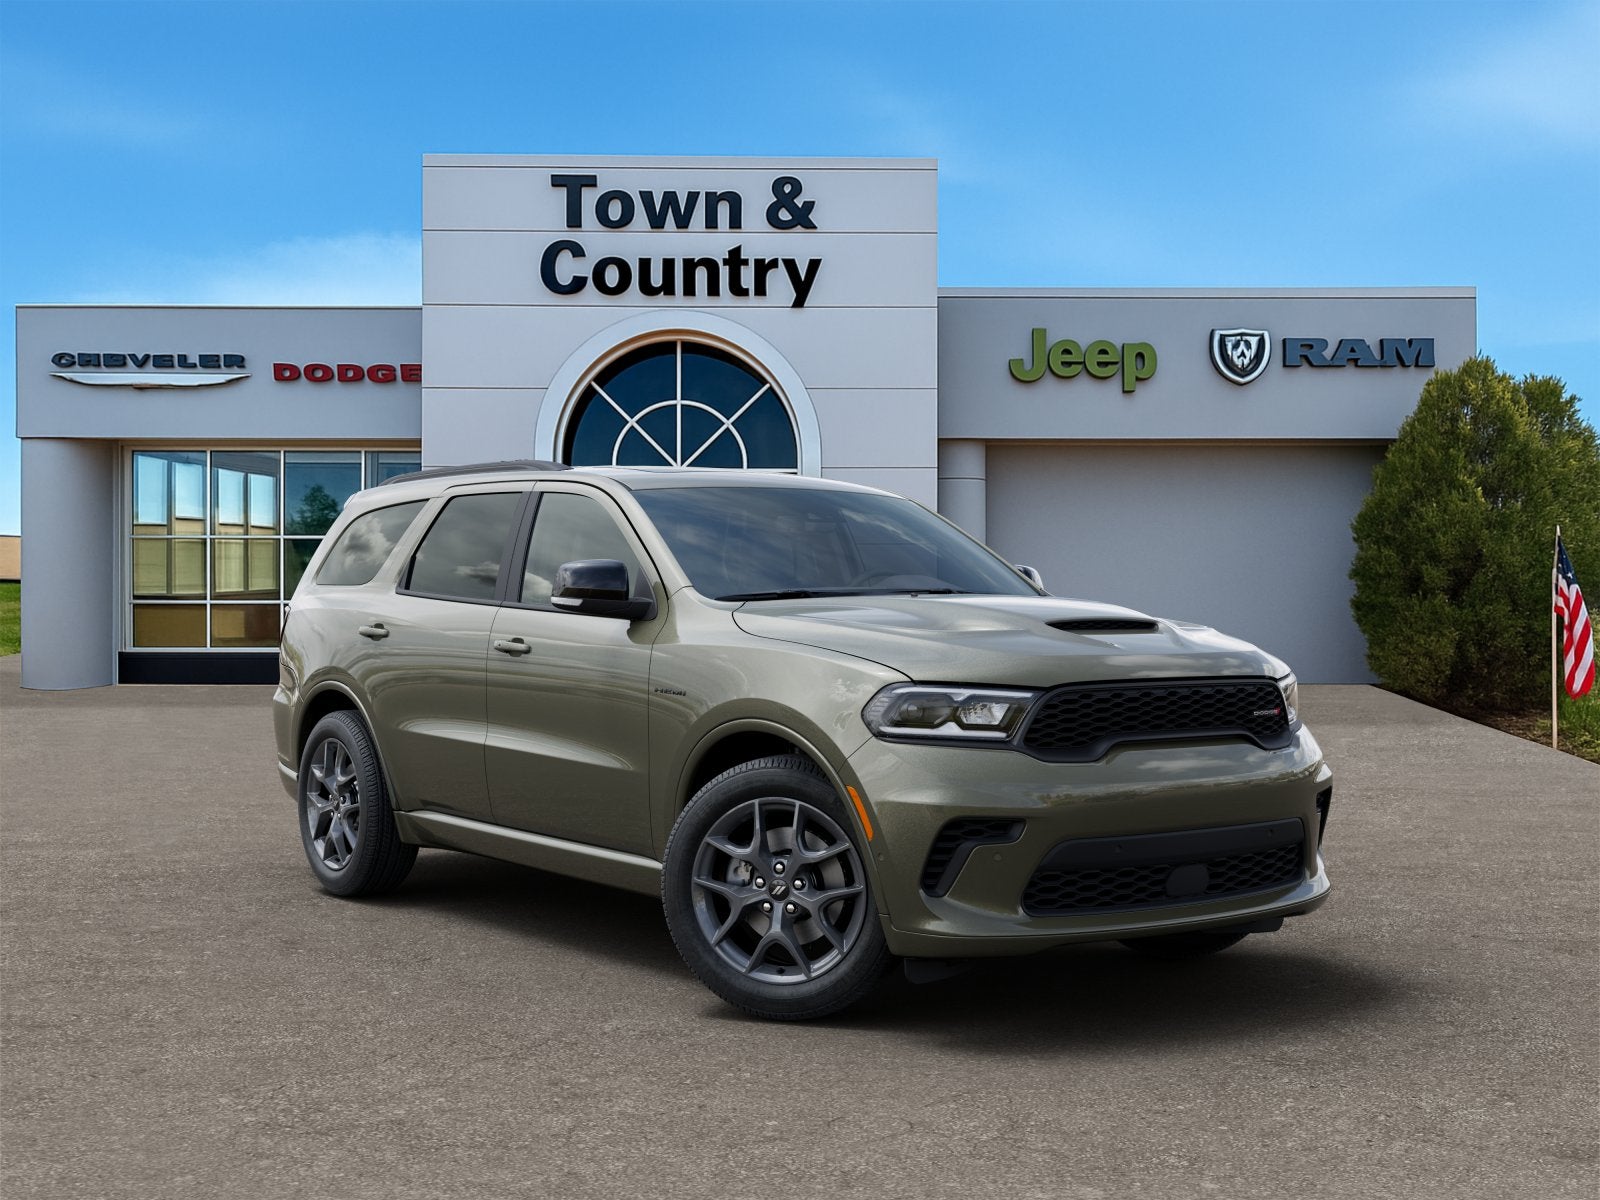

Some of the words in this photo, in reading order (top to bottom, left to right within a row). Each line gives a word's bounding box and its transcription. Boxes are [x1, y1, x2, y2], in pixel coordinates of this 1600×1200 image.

[550, 174, 743, 230] Town
[765, 175, 818, 230] &
[539, 239, 823, 308] Country
[272, 362, 422, 383] DODGE
[1009, 327, 1157, 393] Jeep
[1283, 337, 1436, 368] RAM
